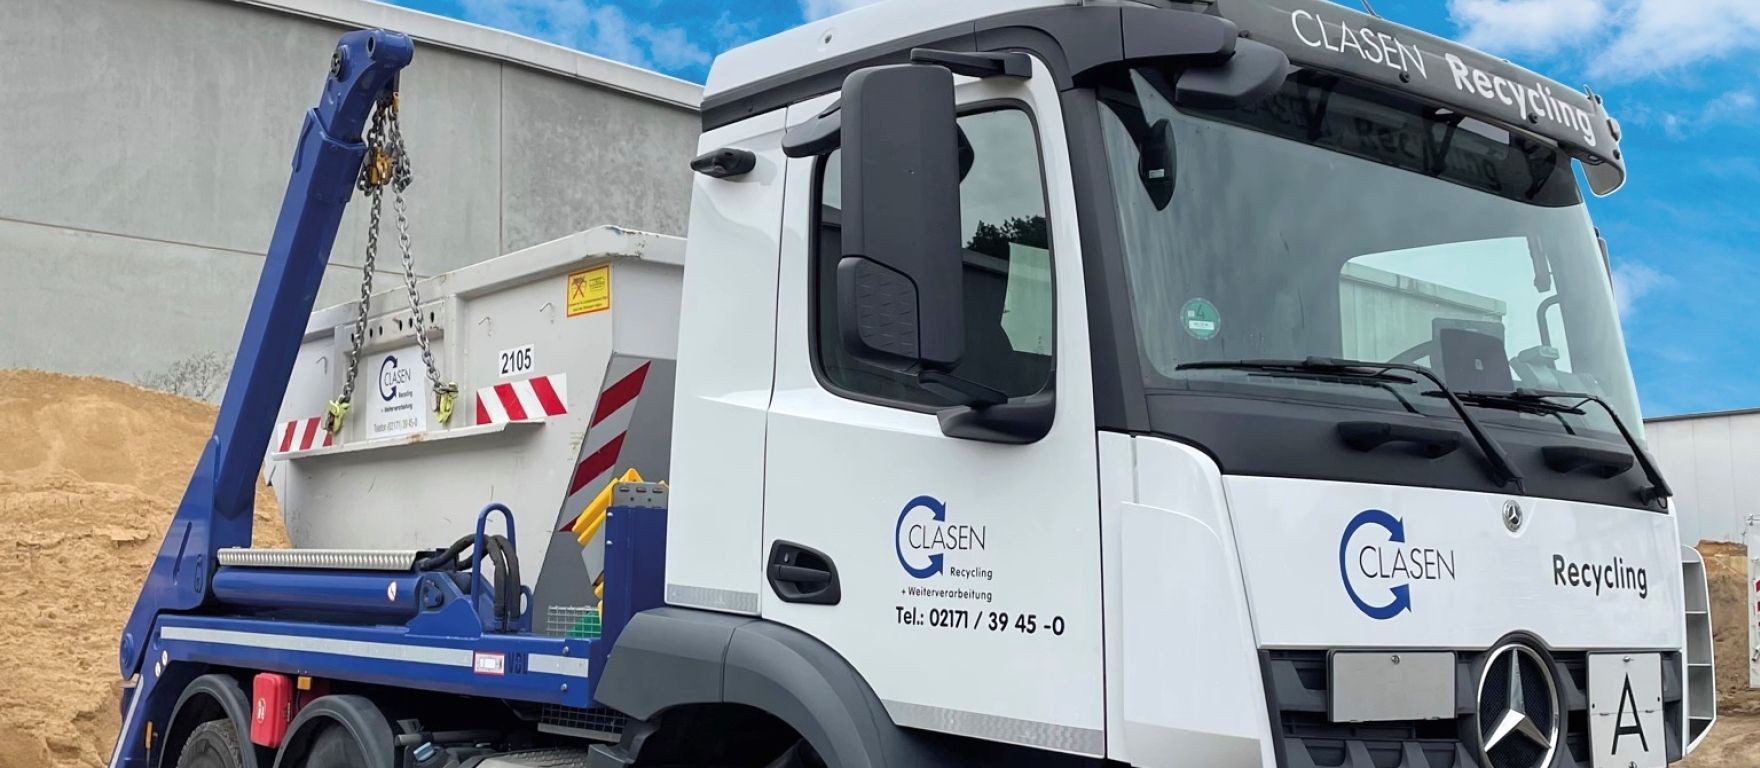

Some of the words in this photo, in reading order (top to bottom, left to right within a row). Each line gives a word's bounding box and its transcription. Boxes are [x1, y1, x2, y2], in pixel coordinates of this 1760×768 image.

[1292, 9, 1428, 80] CLASEN
[1445, 53, 1597, 147] Recycling
[501, 347, 532, 374] 2105
[384, 368, 411, 386] CLASEN
[908, 524, 986, 550] CLASEN
[950, 567, 993, 580] Recycling
[1359, 545, 1456, 581] CLASEN
[1553, 554, 1648, 599] Recycling
[908, 587, 993, 602] Weiterverarbeitung
[896, 606, 924, 625] Tel.:
[929, 608, 968, 629] 02171
[974, 611, 983, 630] /
[988, 612, 1009, 632] 39
[1015, 614, 1036, 634] 45
[1043, 615, 1065, 636] -0
[1611, 672, 1649, 755] A
